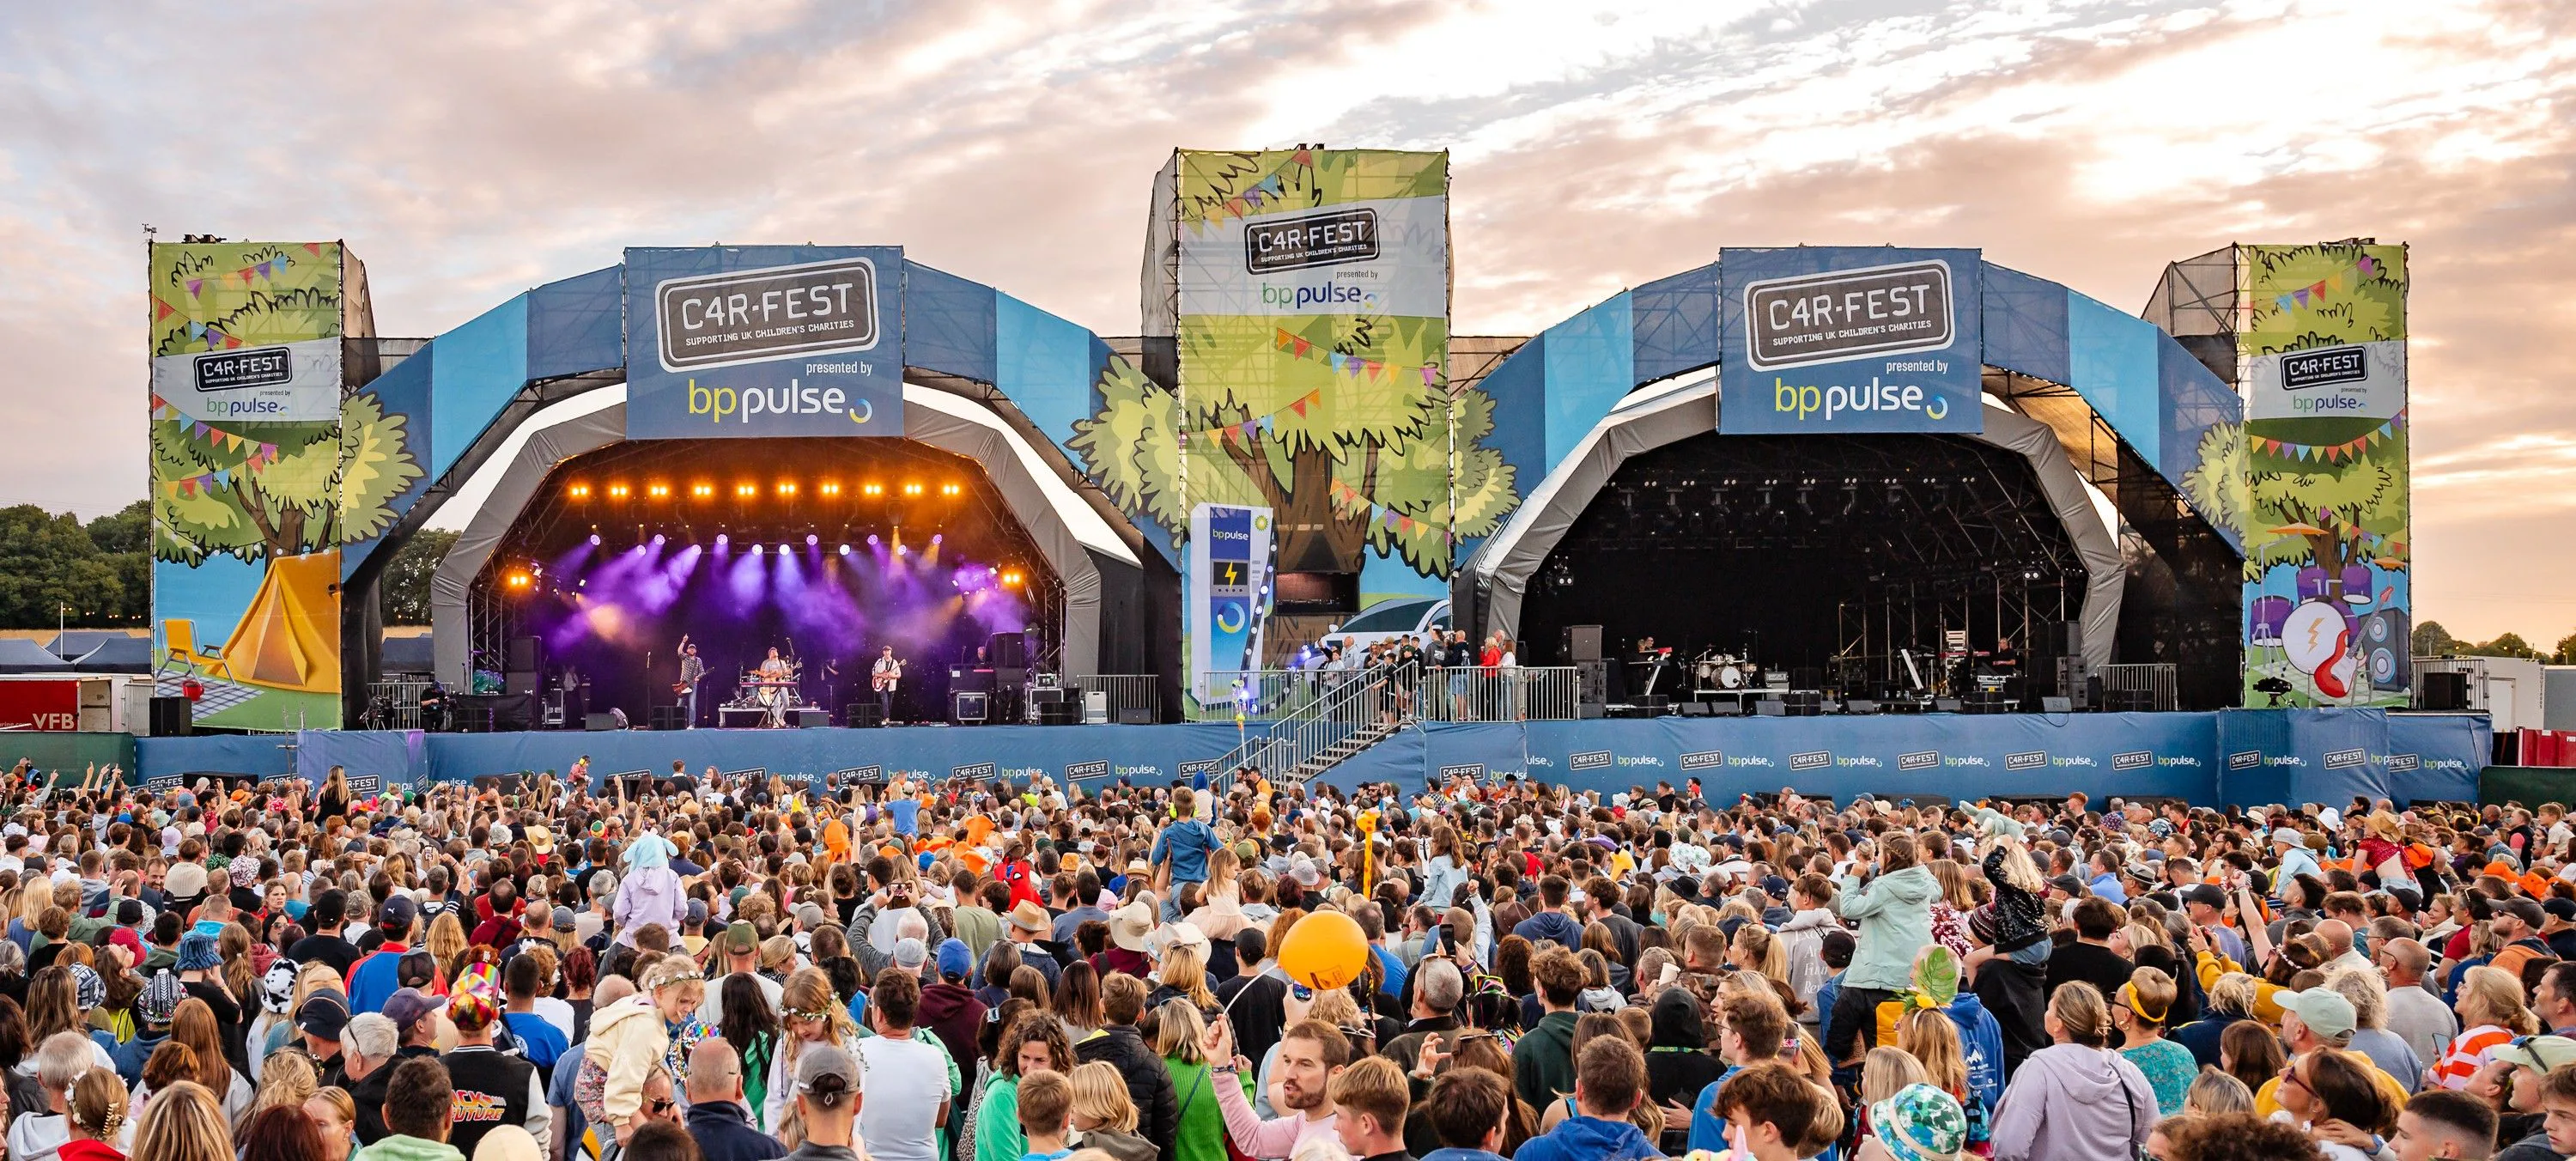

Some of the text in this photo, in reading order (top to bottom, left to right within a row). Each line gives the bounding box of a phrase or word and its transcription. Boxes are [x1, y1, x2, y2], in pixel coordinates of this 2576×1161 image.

[1261, 253, 1295, 263] SUPPORTING
[1338, 243, 1367, 252] CHARITIES
[1336, 270, 1378, 280] presented by
[686, 320, 855, 346] SUPPORTING UK CHILDREN'S CHARITIES
[1773, 320, 1931, 346] SUPPORTING UK CHILDREN'S CHARITIES
[806, 361, 872, 376] presented by
[1886, 360, 1948, 374] presented by
[33, 713, 75, 729] VFB
[1526, 756, 1546, 765] ulse
[453, 1107, 505, 1122] UTURE
